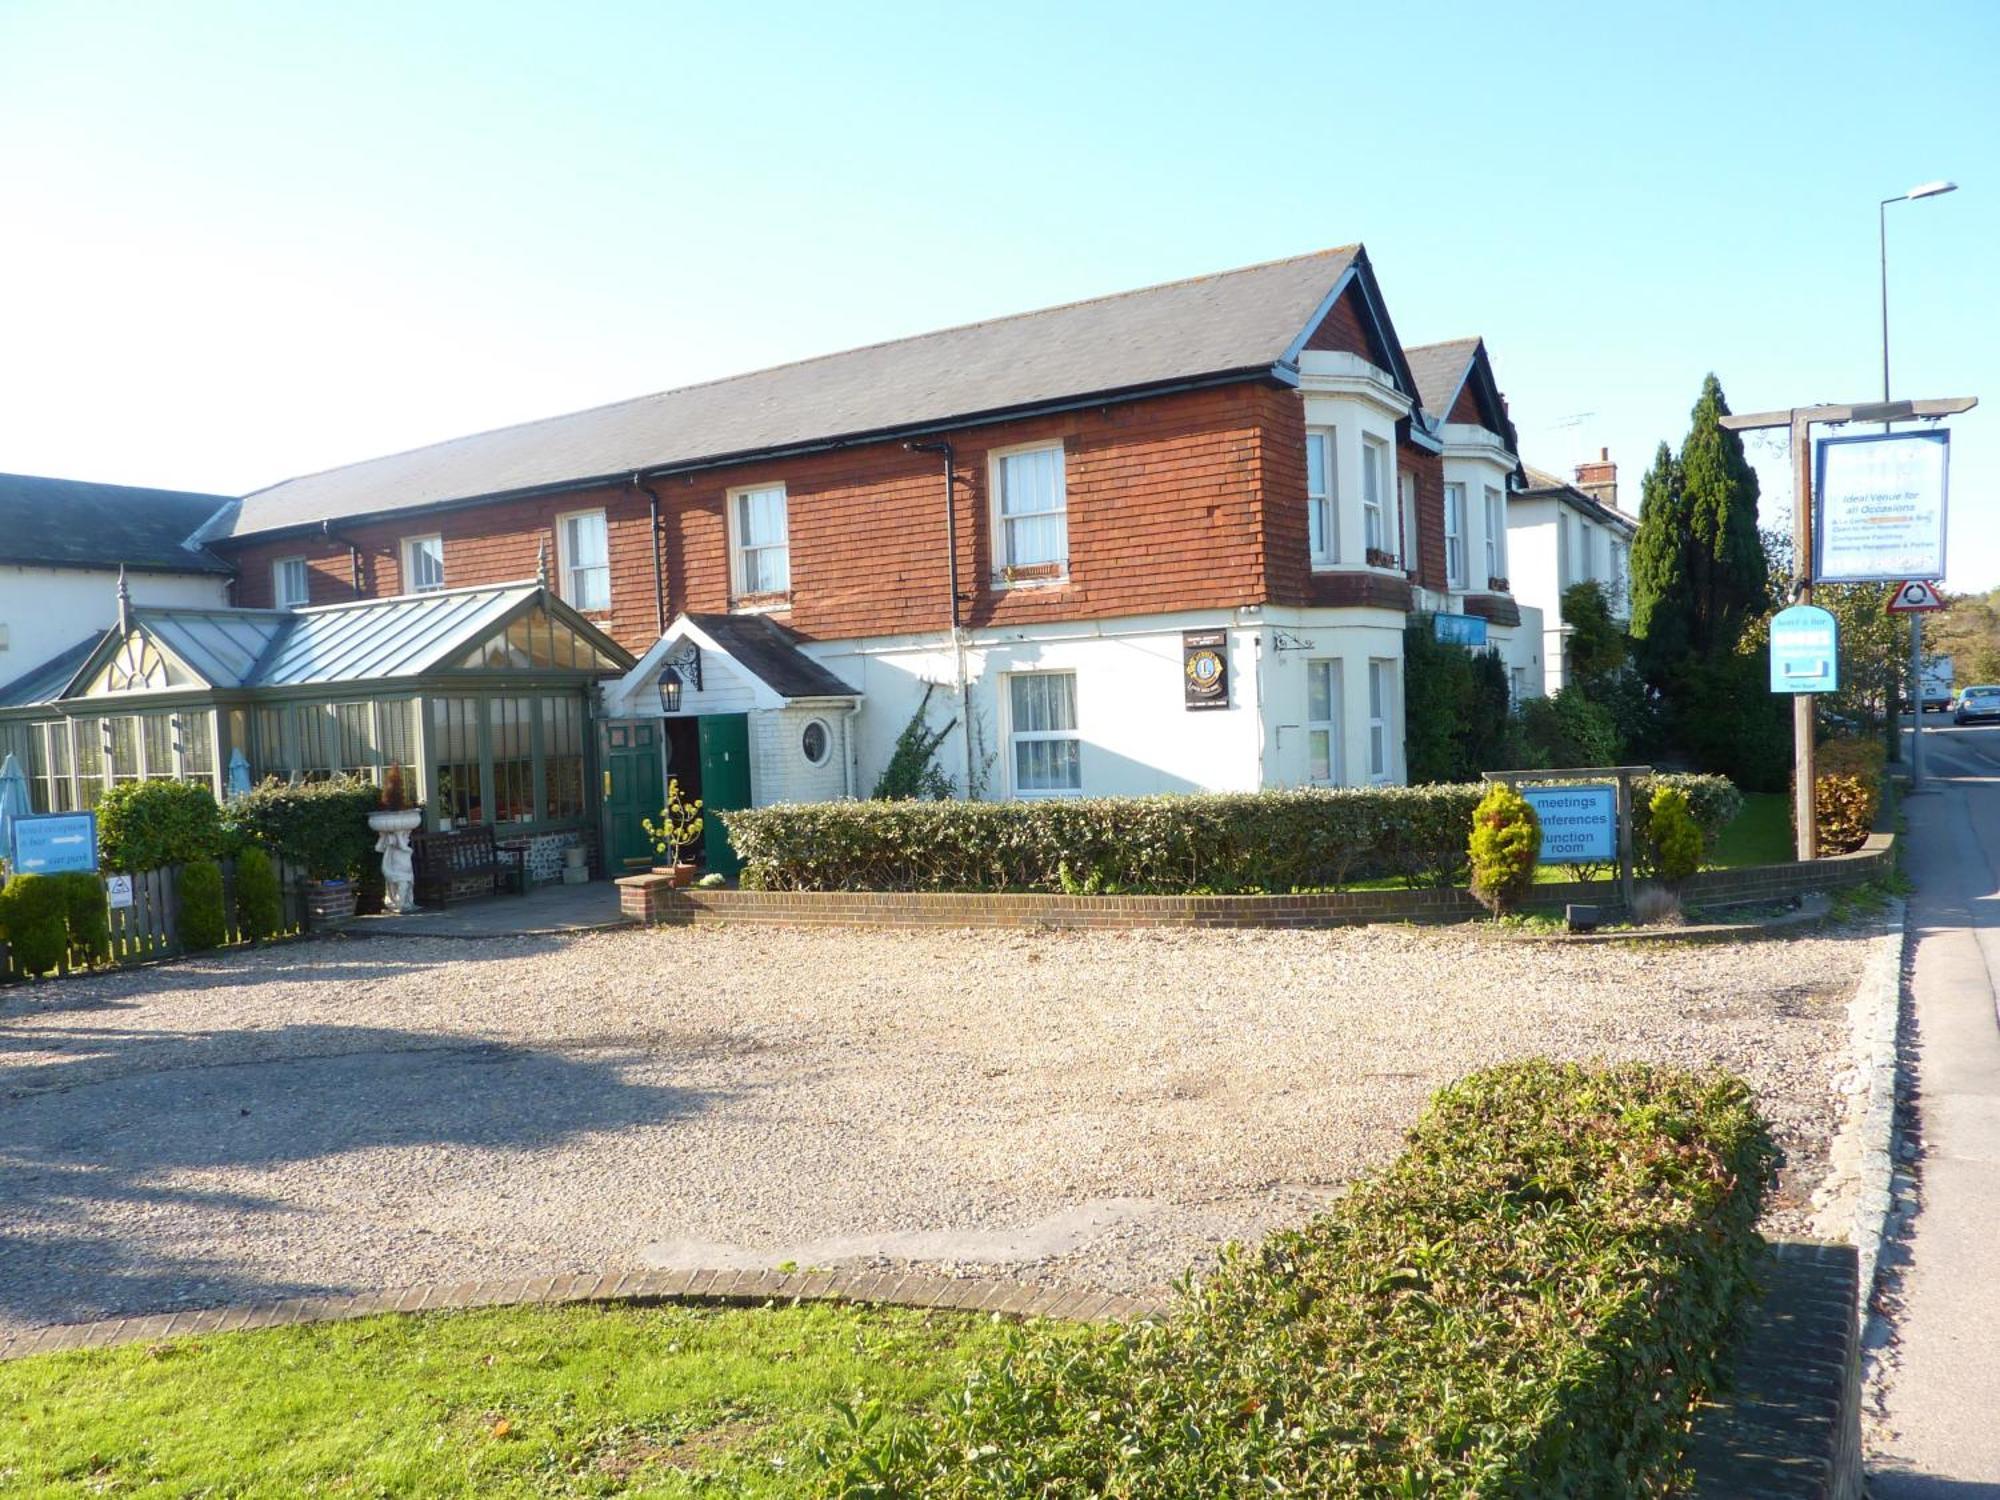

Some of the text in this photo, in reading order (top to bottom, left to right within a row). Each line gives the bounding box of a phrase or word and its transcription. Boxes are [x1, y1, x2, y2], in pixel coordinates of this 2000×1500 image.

[1843, 491, 1920, 503] Ideal Venue for
[1861, 504, 1916, 514] Occasions
[1537, 798, 1597, 809] meetings
[1537, 815, 1608, 826] onferences
[1551, 844, 1584, 853] room
